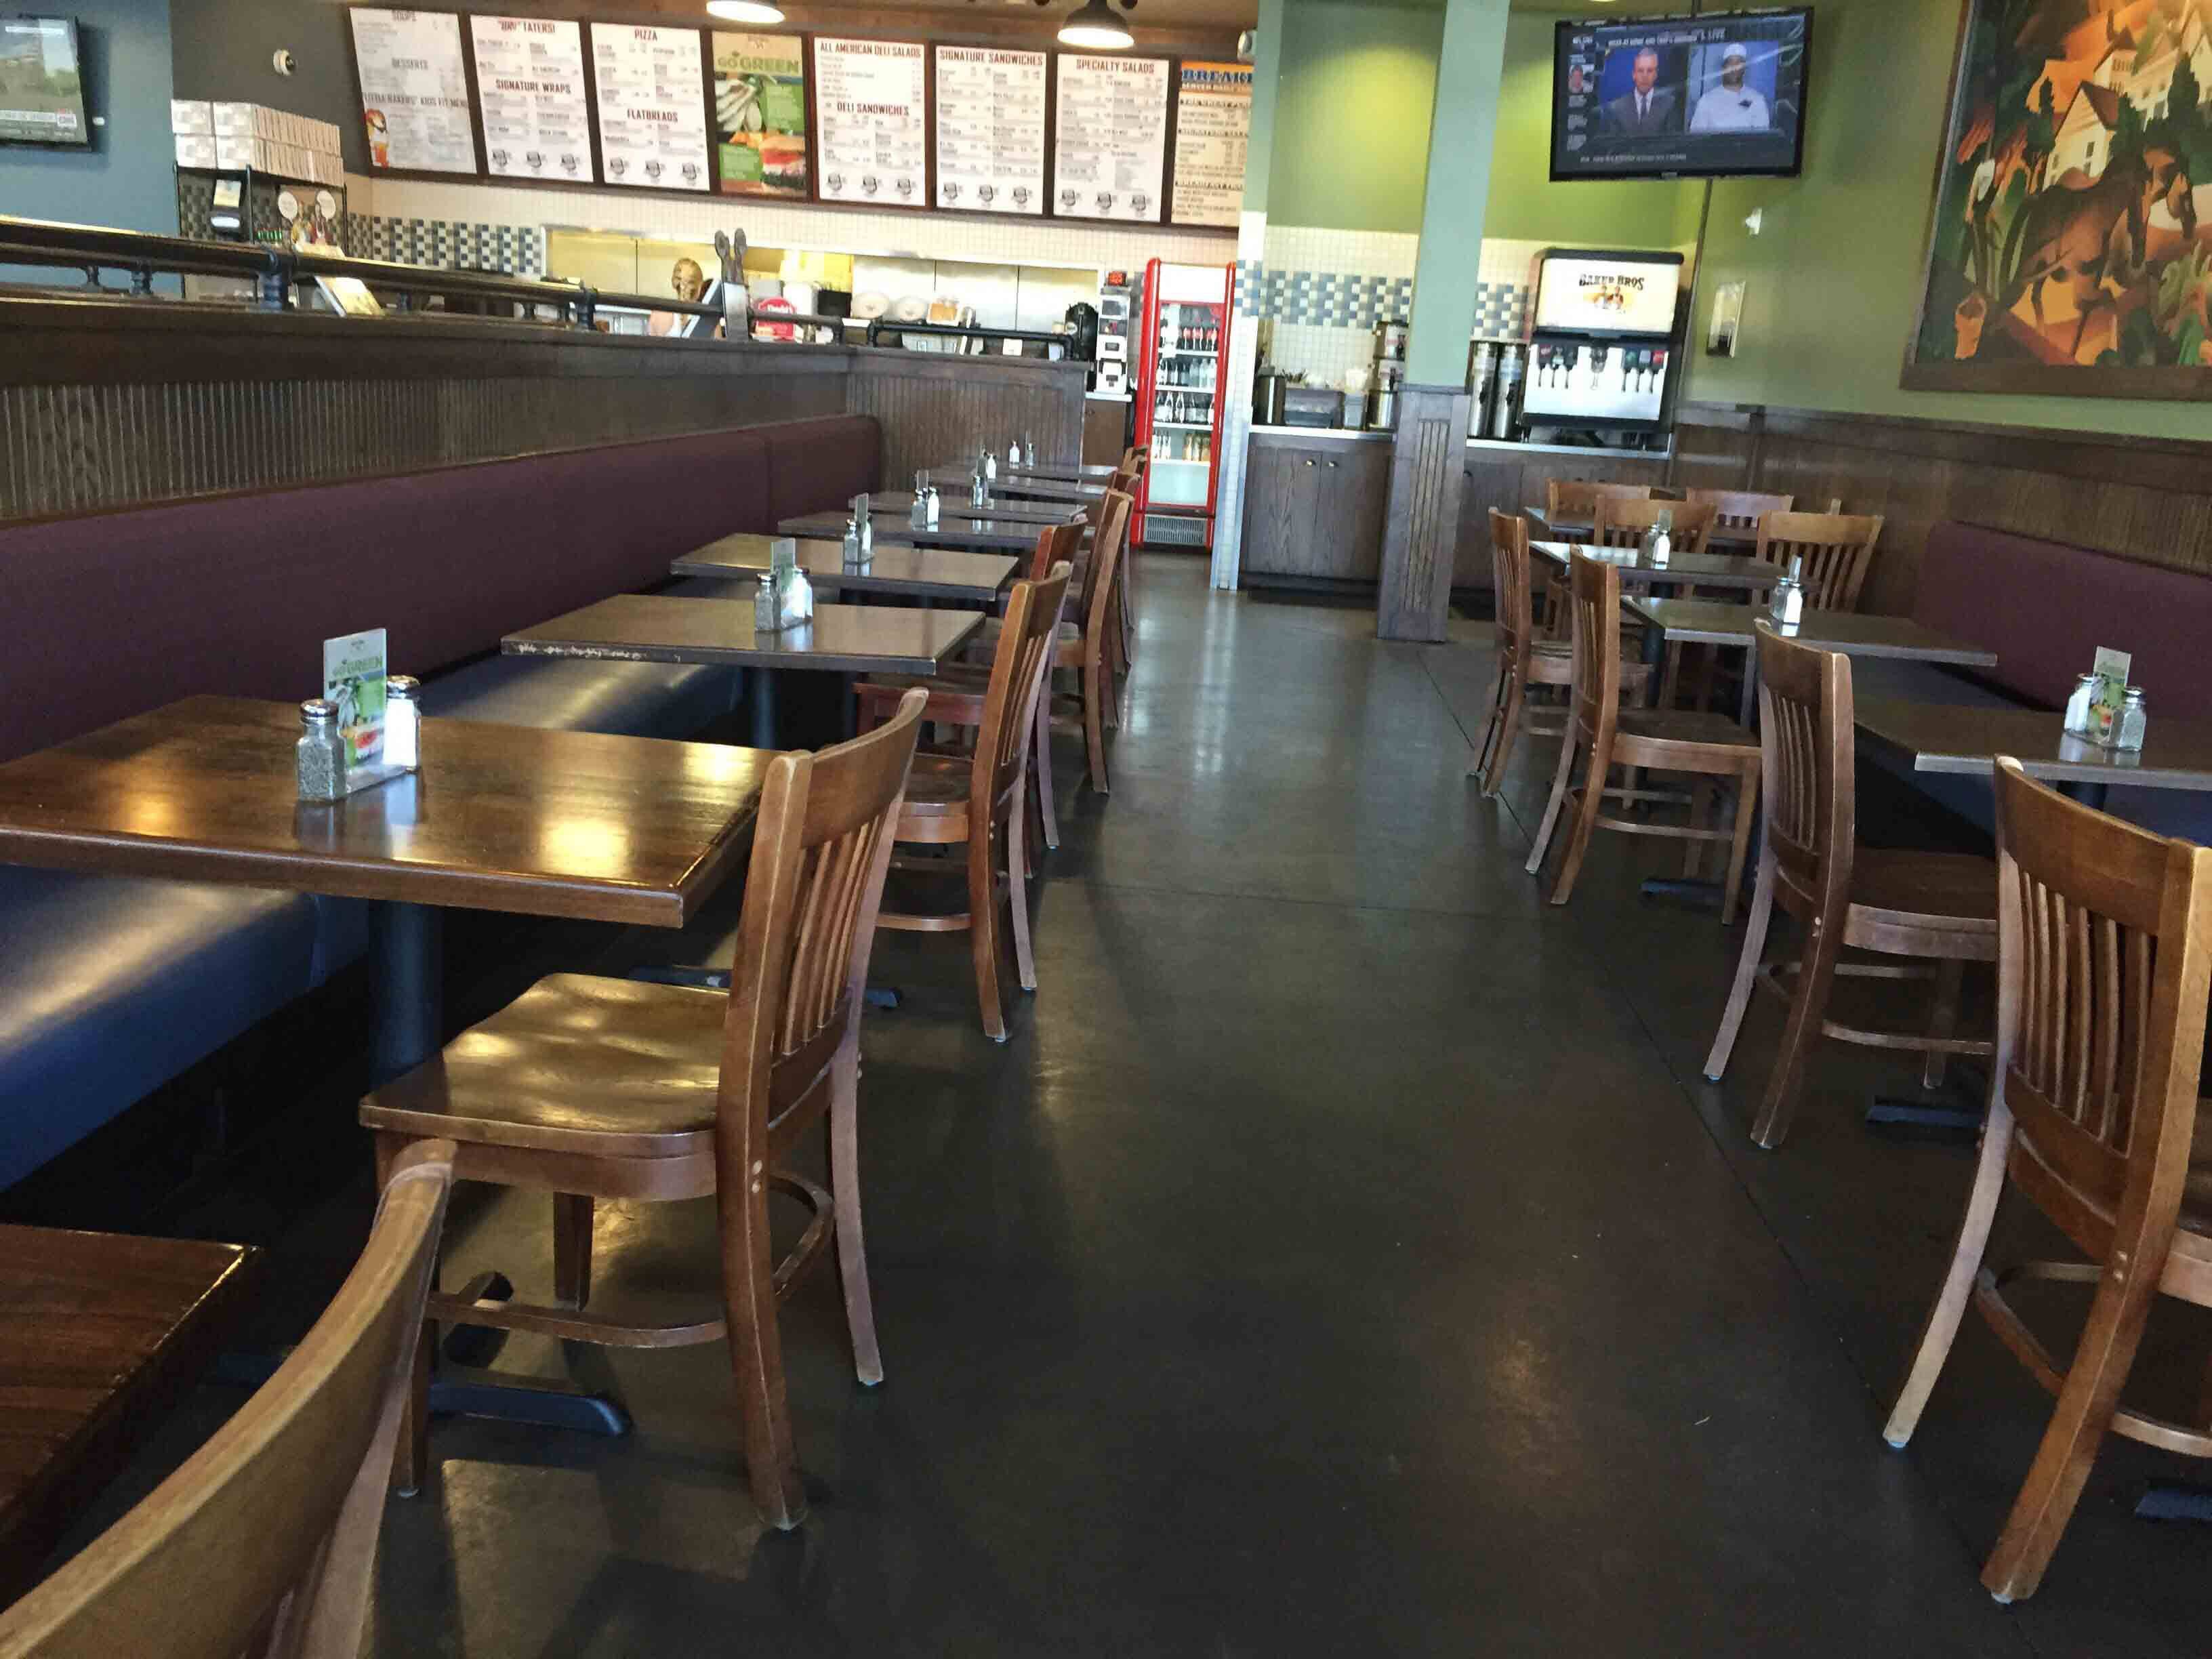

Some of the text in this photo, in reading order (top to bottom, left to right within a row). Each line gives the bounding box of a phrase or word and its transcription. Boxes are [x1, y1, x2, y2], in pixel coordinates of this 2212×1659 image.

[634, 28, 657, 41] PIZZA
[821, 43, 921, 58] ALL AMERICAN DELI SALADS
[940, 49, 1042, 66] SIGNATURE SANDWICHES
[718, 57, 799, 74] GO GREEN
[1076, 59, 1154, 74] SPECIALTY SALADS
[495, 79, 571, 94] SIGNATURE WRAPS
[627, 108, 678, 123] FLATBREADS
[837, 102, 909, 117] DELI SANDWICHES
[1618, 274, 1644, 291] BROS
